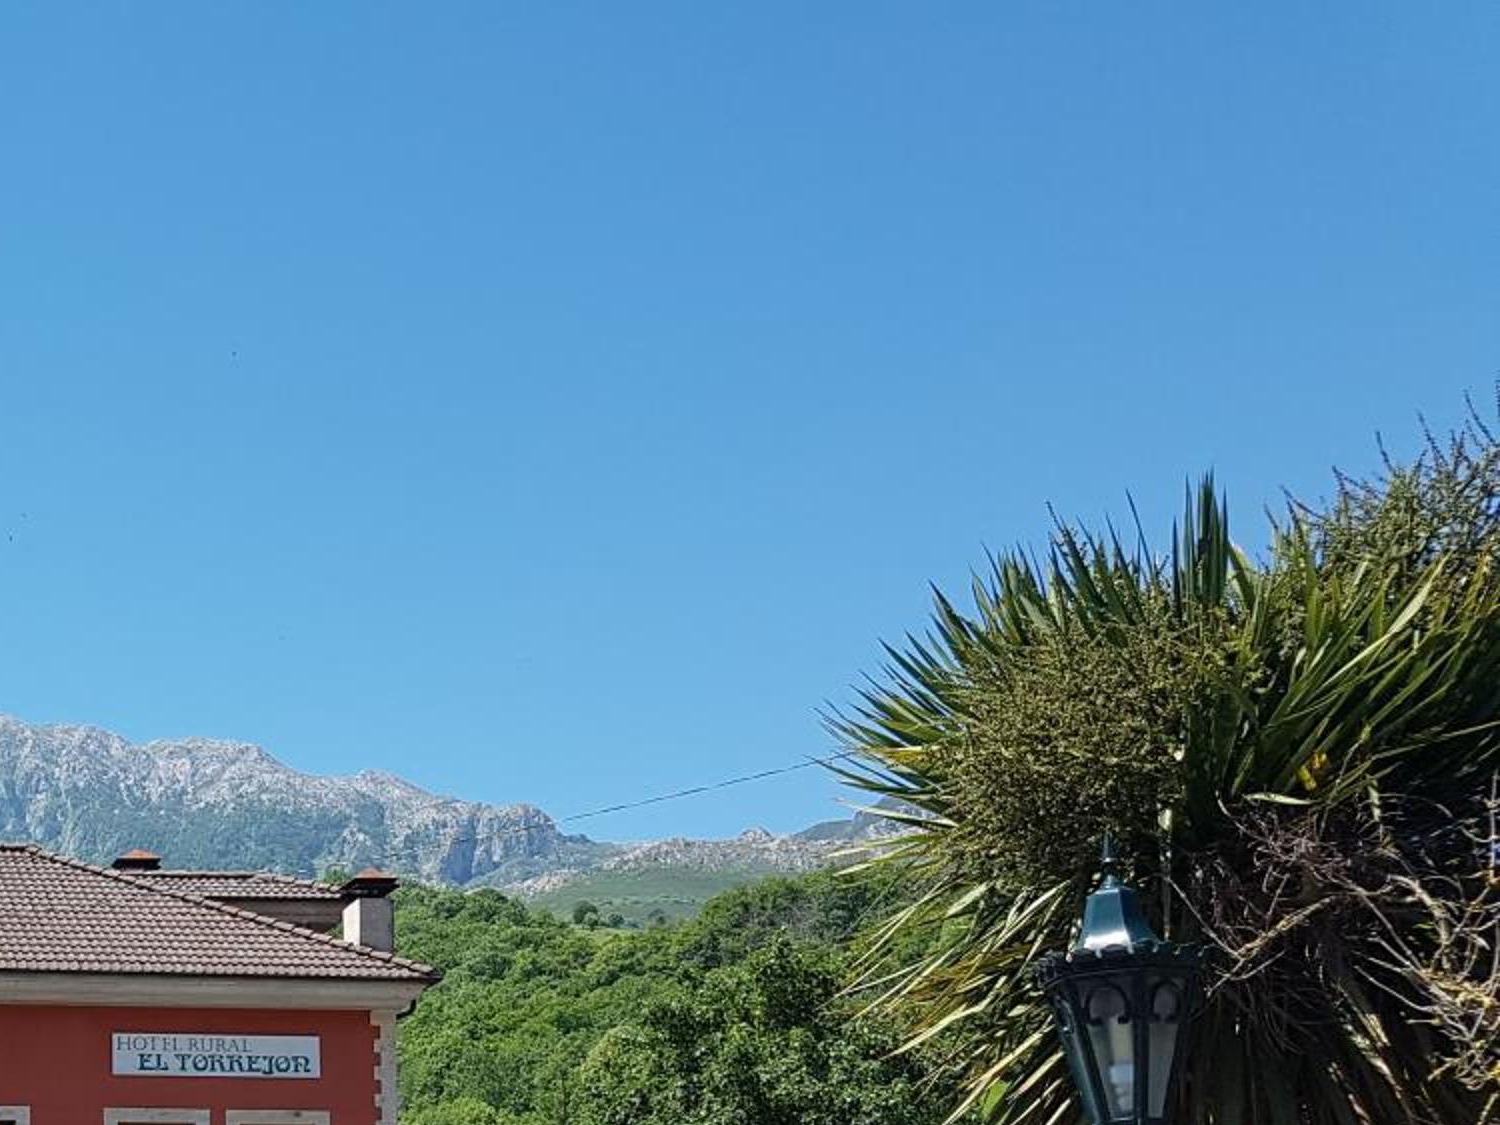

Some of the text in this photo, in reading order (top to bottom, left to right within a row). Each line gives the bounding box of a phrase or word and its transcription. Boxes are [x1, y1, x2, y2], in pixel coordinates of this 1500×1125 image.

[116, 1036, 253, 1053] HOTEL RURAL
[137, 1053, 169, 1071] EL
